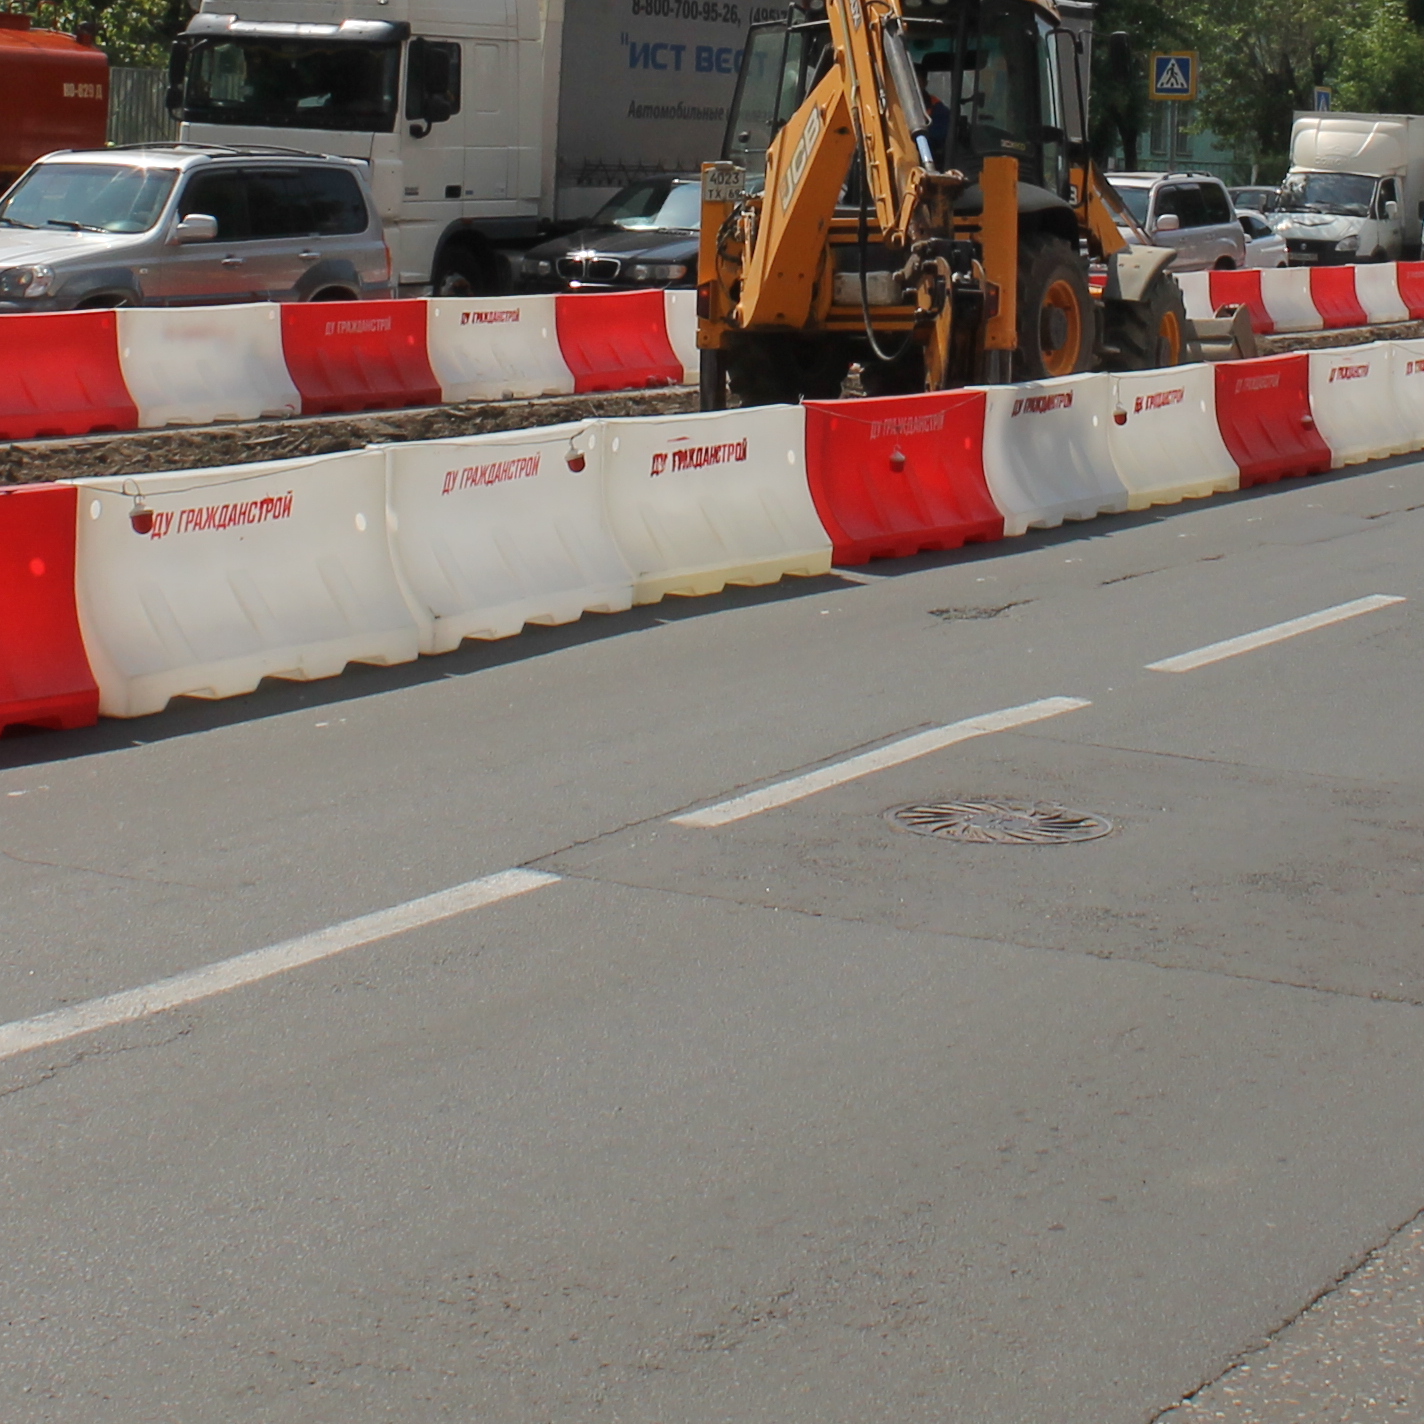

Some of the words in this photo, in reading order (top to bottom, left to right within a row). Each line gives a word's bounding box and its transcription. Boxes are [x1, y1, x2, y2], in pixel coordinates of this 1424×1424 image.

[628, 99, 725, 122] Автомобильные
[779, 105, 820, 213] JCB
[709, 172, 740, 185] 4023
[441, 469, 459, 496] ДУ
[459, 451, 541, 490] ГРАЖДАНСТРОЙ
[650, 452, 668, 478] ДУ
[150, 511, 175, 540] ДУ
[176, 489, 294, 534] ГРАЖДАНСТРОЙ
